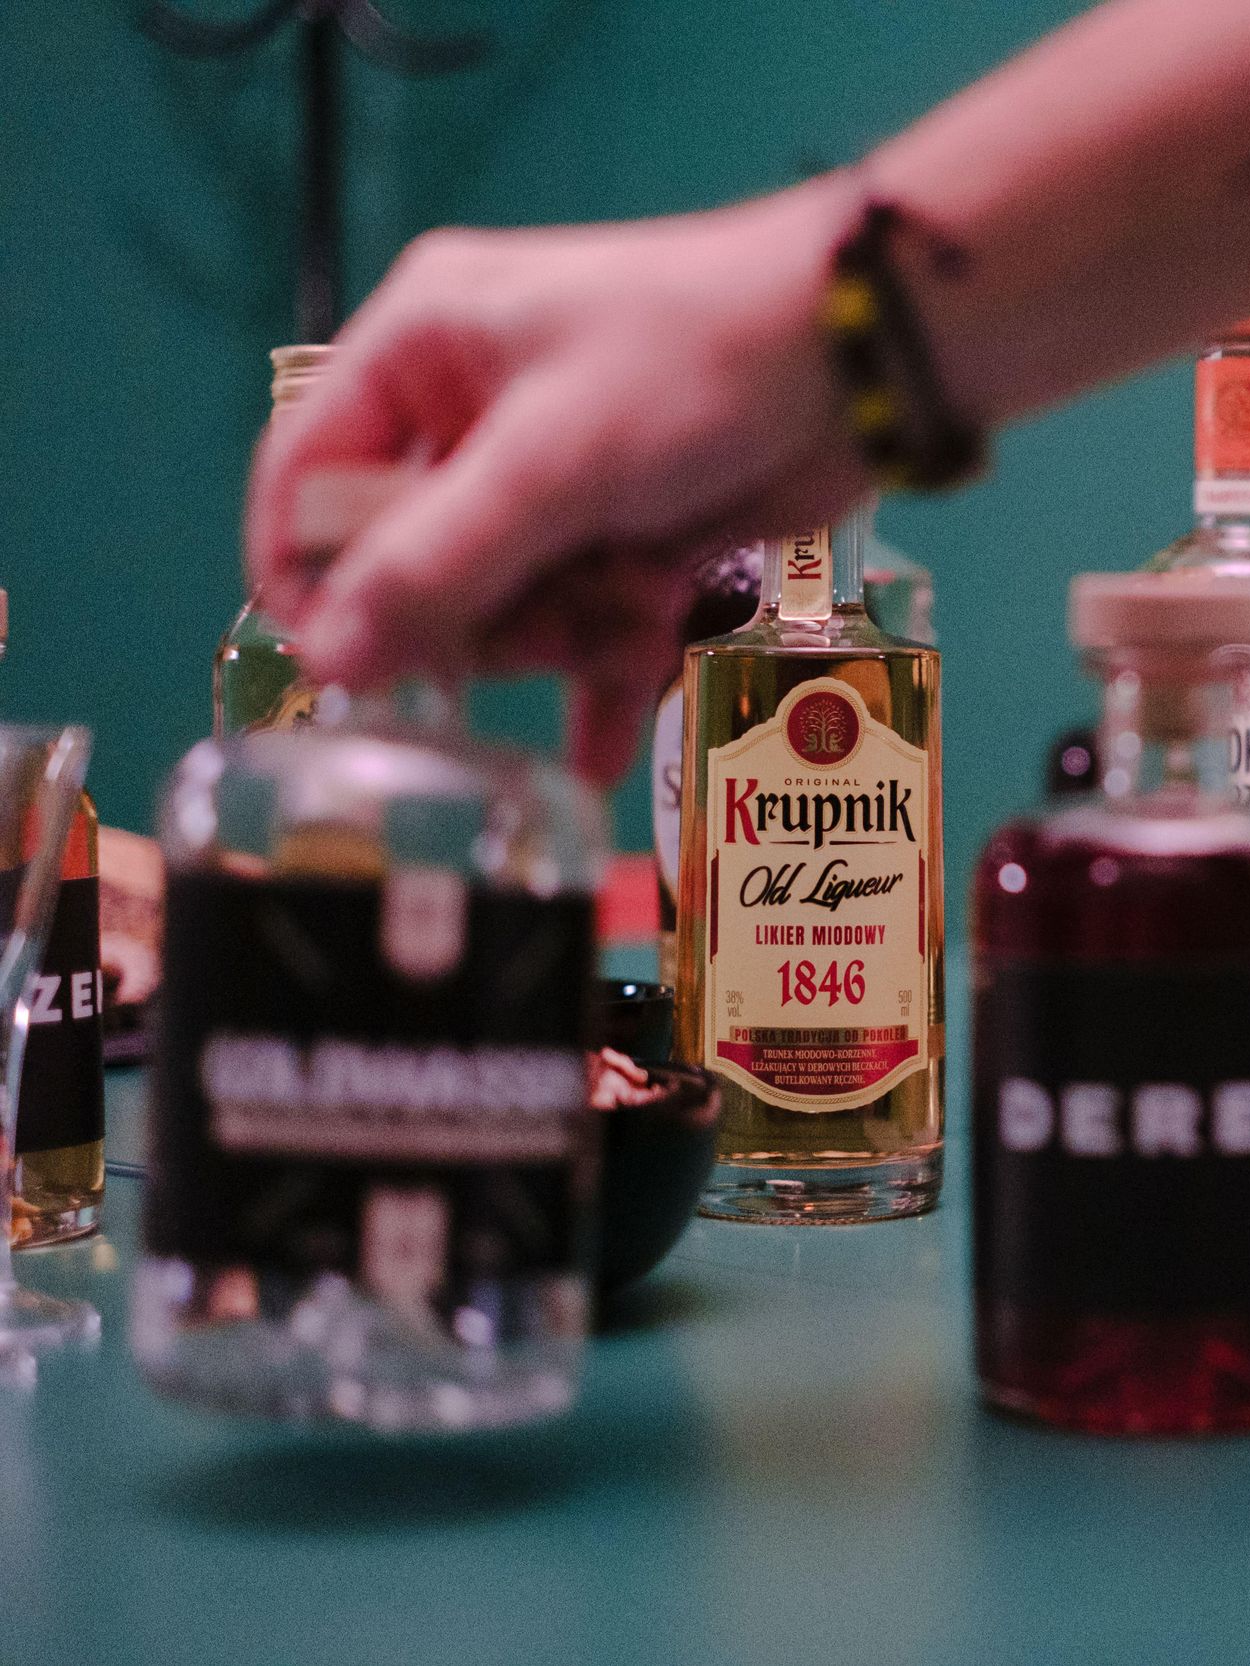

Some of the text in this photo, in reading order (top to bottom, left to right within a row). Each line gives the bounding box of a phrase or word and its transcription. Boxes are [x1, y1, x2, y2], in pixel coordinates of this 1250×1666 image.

[784, 778, 860, 786] ORIGINAL
[724, 778, 916, 850] Krupnik
[739, 859, 903, 912] Old Liqueur
[755, 925, 886, 945] LIKIER MIODOWY
[777, 959, 866, 1007] 1846
[27, 969, 103, 1023] ZE
[725, 990, 744, 1004] 38%
[898, 990, 912, 1004] 500
[727, 1004, 742, 1018] vol.
[900, 1004, 910, 1017] ml
[734, 1028, 776, 1043] POLSKA
[780, 1029, 840, 1043] TRADYCJA
[844, 1029, 859, 1042] OD
[763, 1049, 793, 1059] TRUNEK
[798, 1062, 807, 1072] W
[774, 1075, 833, 1085] BUTELKOWANY
